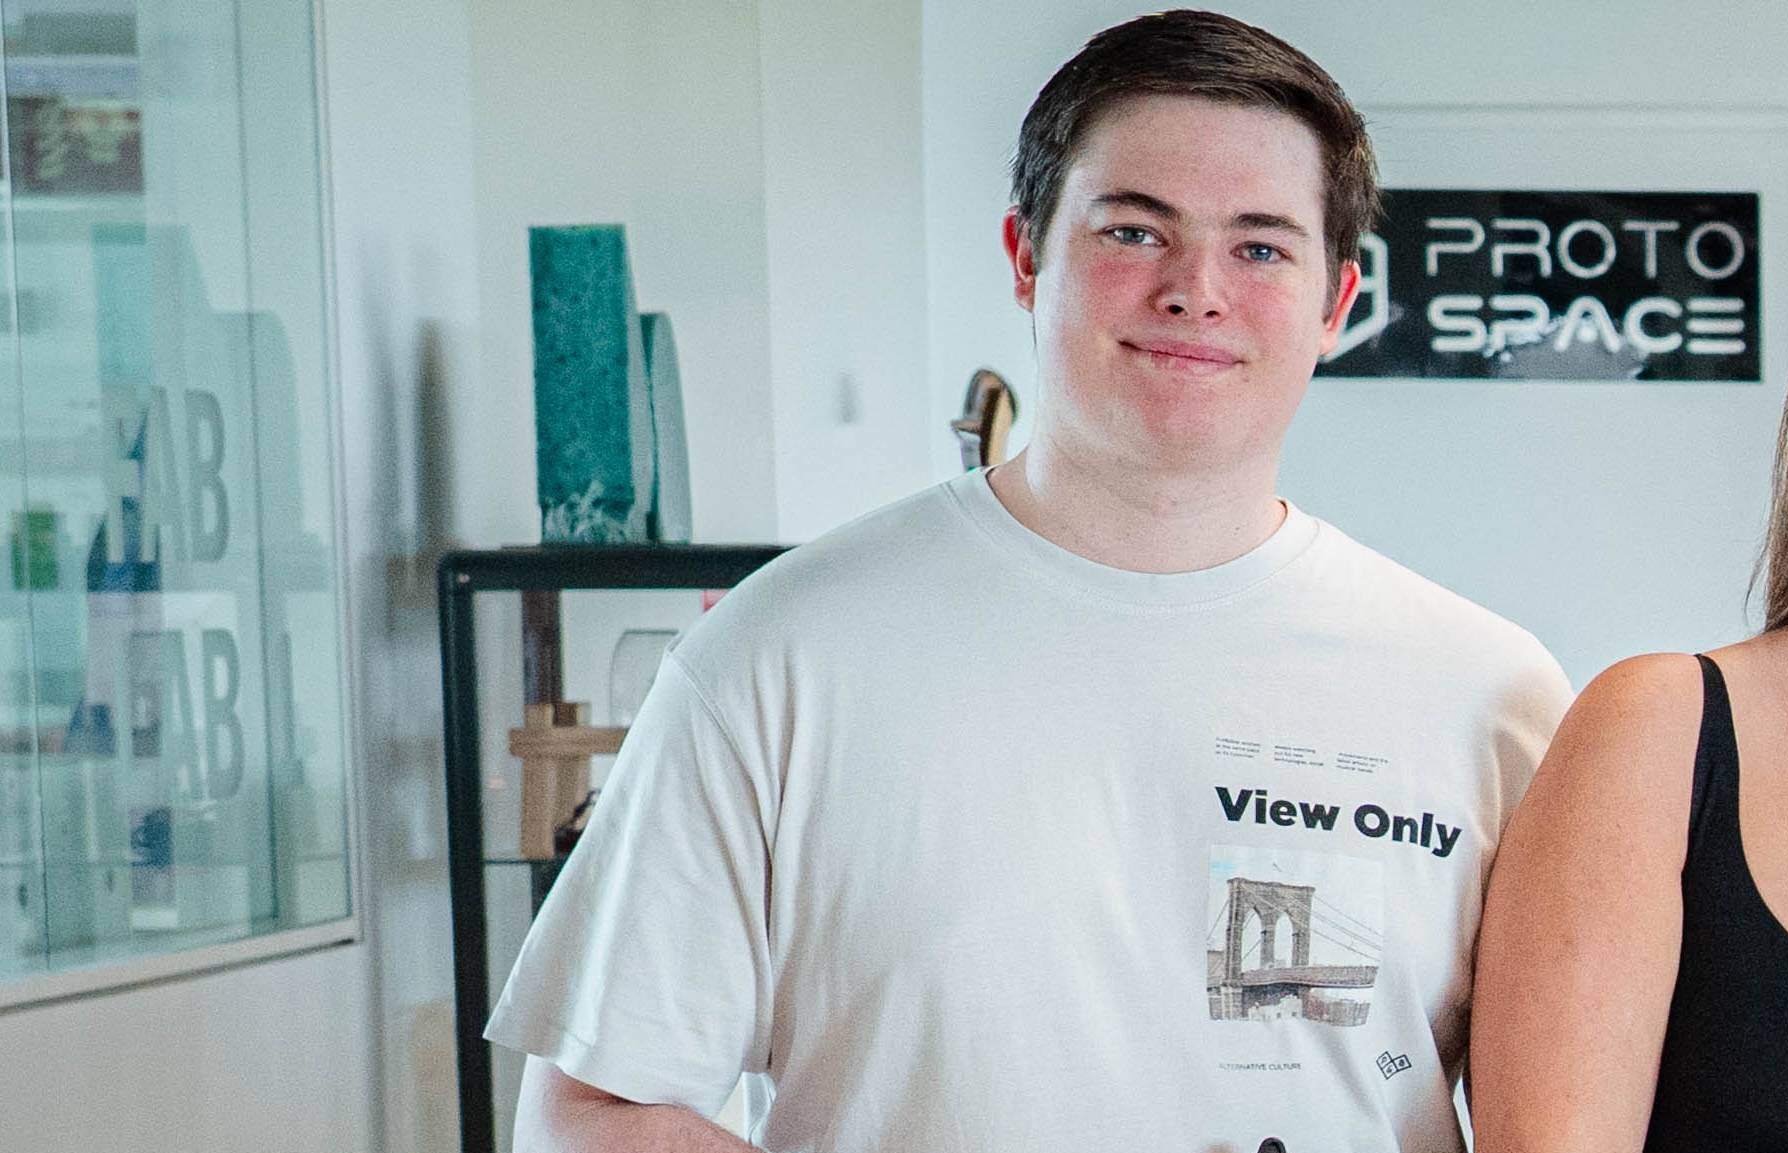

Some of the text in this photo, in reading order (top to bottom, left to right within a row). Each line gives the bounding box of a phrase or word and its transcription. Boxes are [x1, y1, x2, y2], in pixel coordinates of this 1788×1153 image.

[1425, 217, 1745, 280] PROTO
[1427, 294, 1746, 355] SPACE
[1214, 786, 1462, 858] View Only
